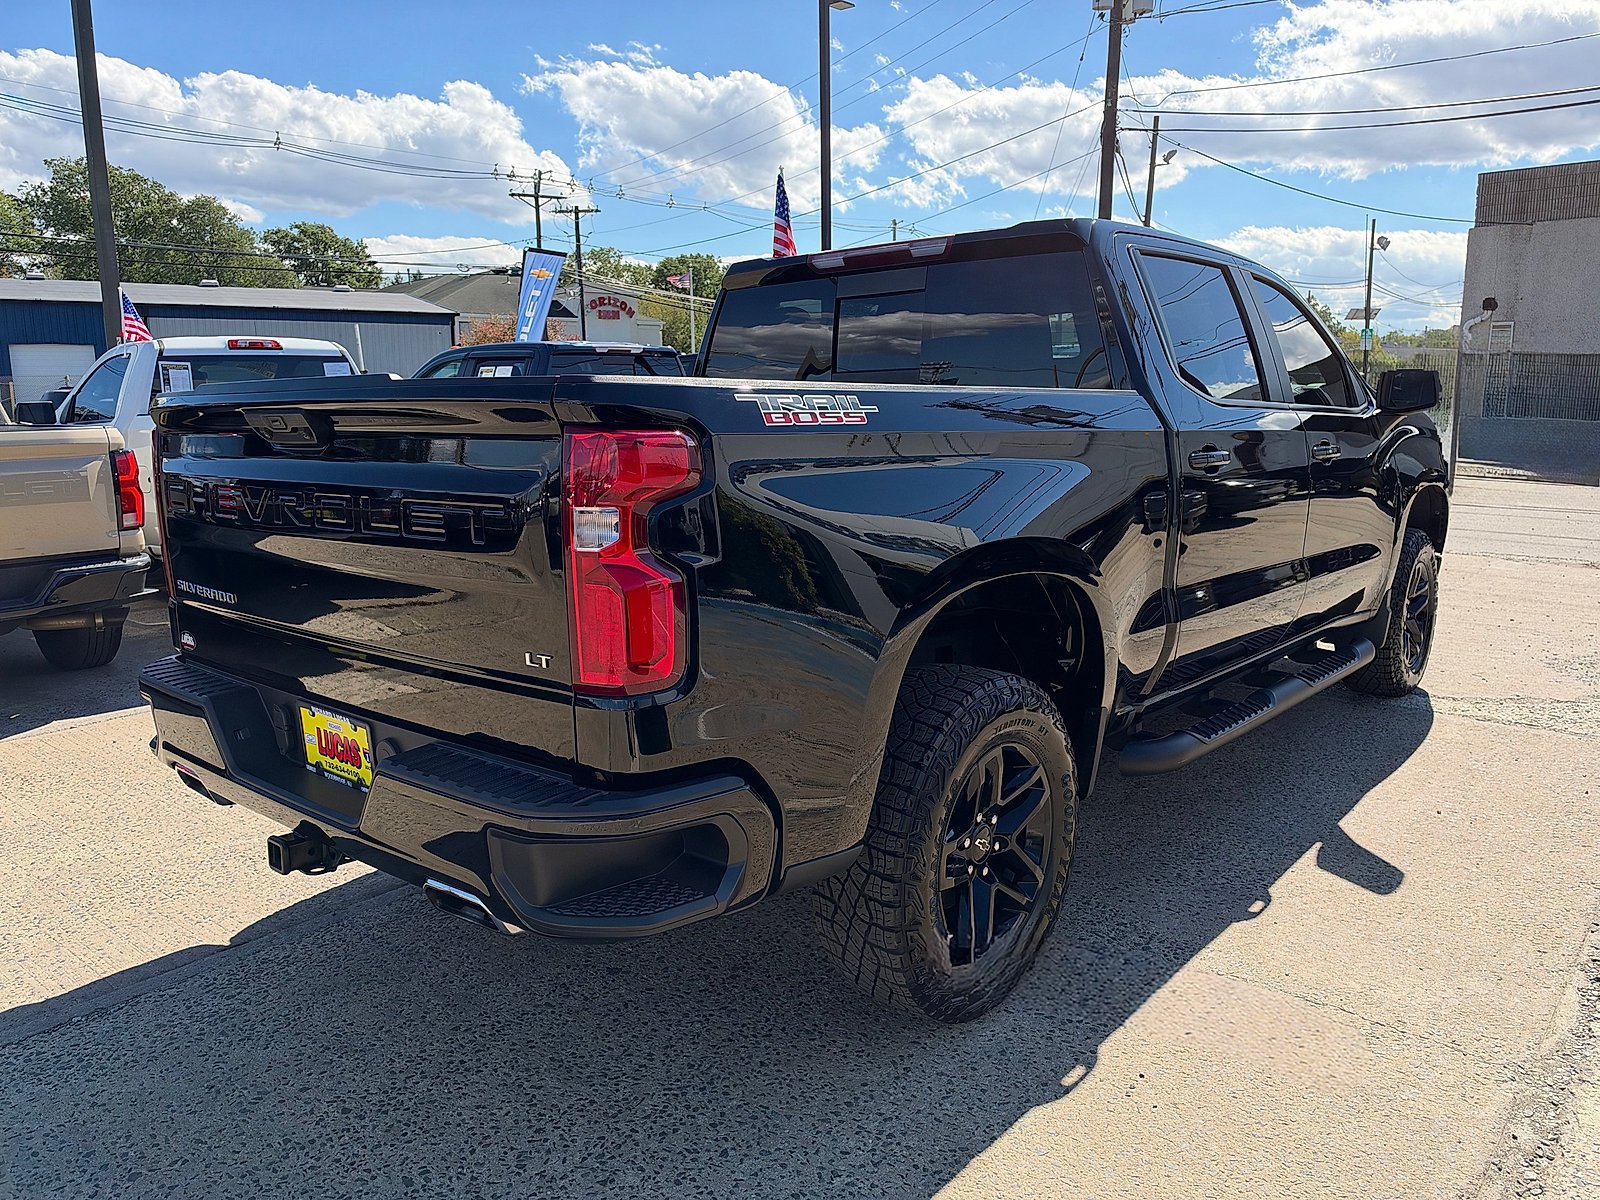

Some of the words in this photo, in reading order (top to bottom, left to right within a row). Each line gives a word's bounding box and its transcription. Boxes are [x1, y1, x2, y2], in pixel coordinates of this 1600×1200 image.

[586, 295, 635, 319] ORIZON
[734, 394, 879, 412] TRAIL
[762, 411, 867, 426] BOSS
[177, 580, 238, 604] SILVERADO
[524, 651, 554, 669] LT
[993, 718, 1036, 735] TERRITORY
[316, 726, 363, 770] LUCAS
